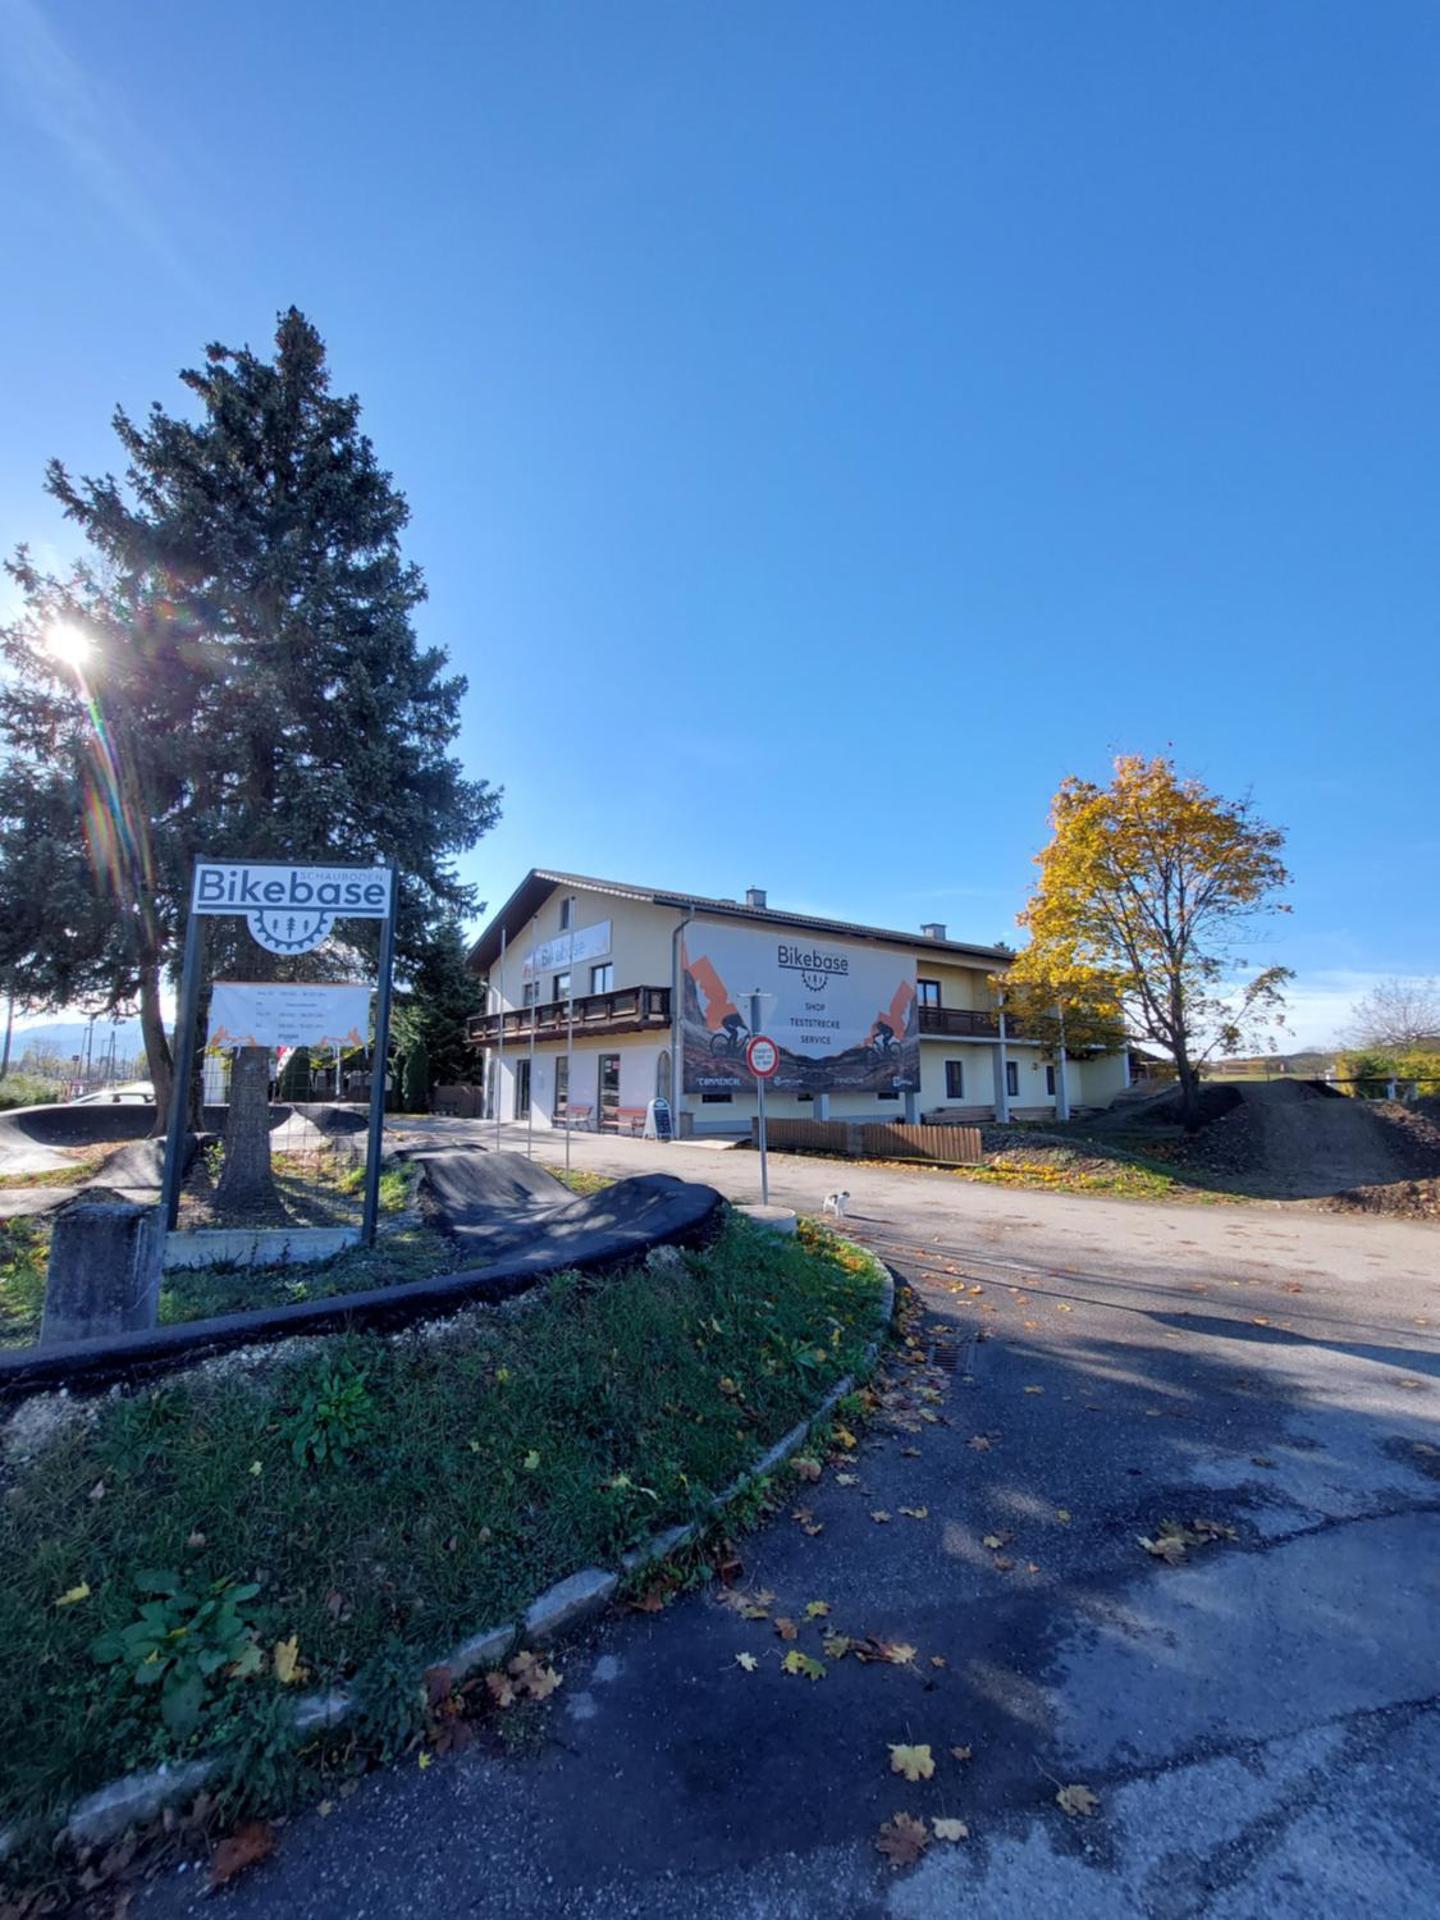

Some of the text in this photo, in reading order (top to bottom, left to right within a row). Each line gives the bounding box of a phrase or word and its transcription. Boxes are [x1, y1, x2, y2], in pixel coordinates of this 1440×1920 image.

[198, 869, 385, 905] Bikebase
[778, 945, 848, 971] Bikebase
[805, 1002, 826, 1011] SHOP
[790, 1017, 841, 1030] TESTSTRECKE
[801, 1035, 831, 1045] SERVICE
